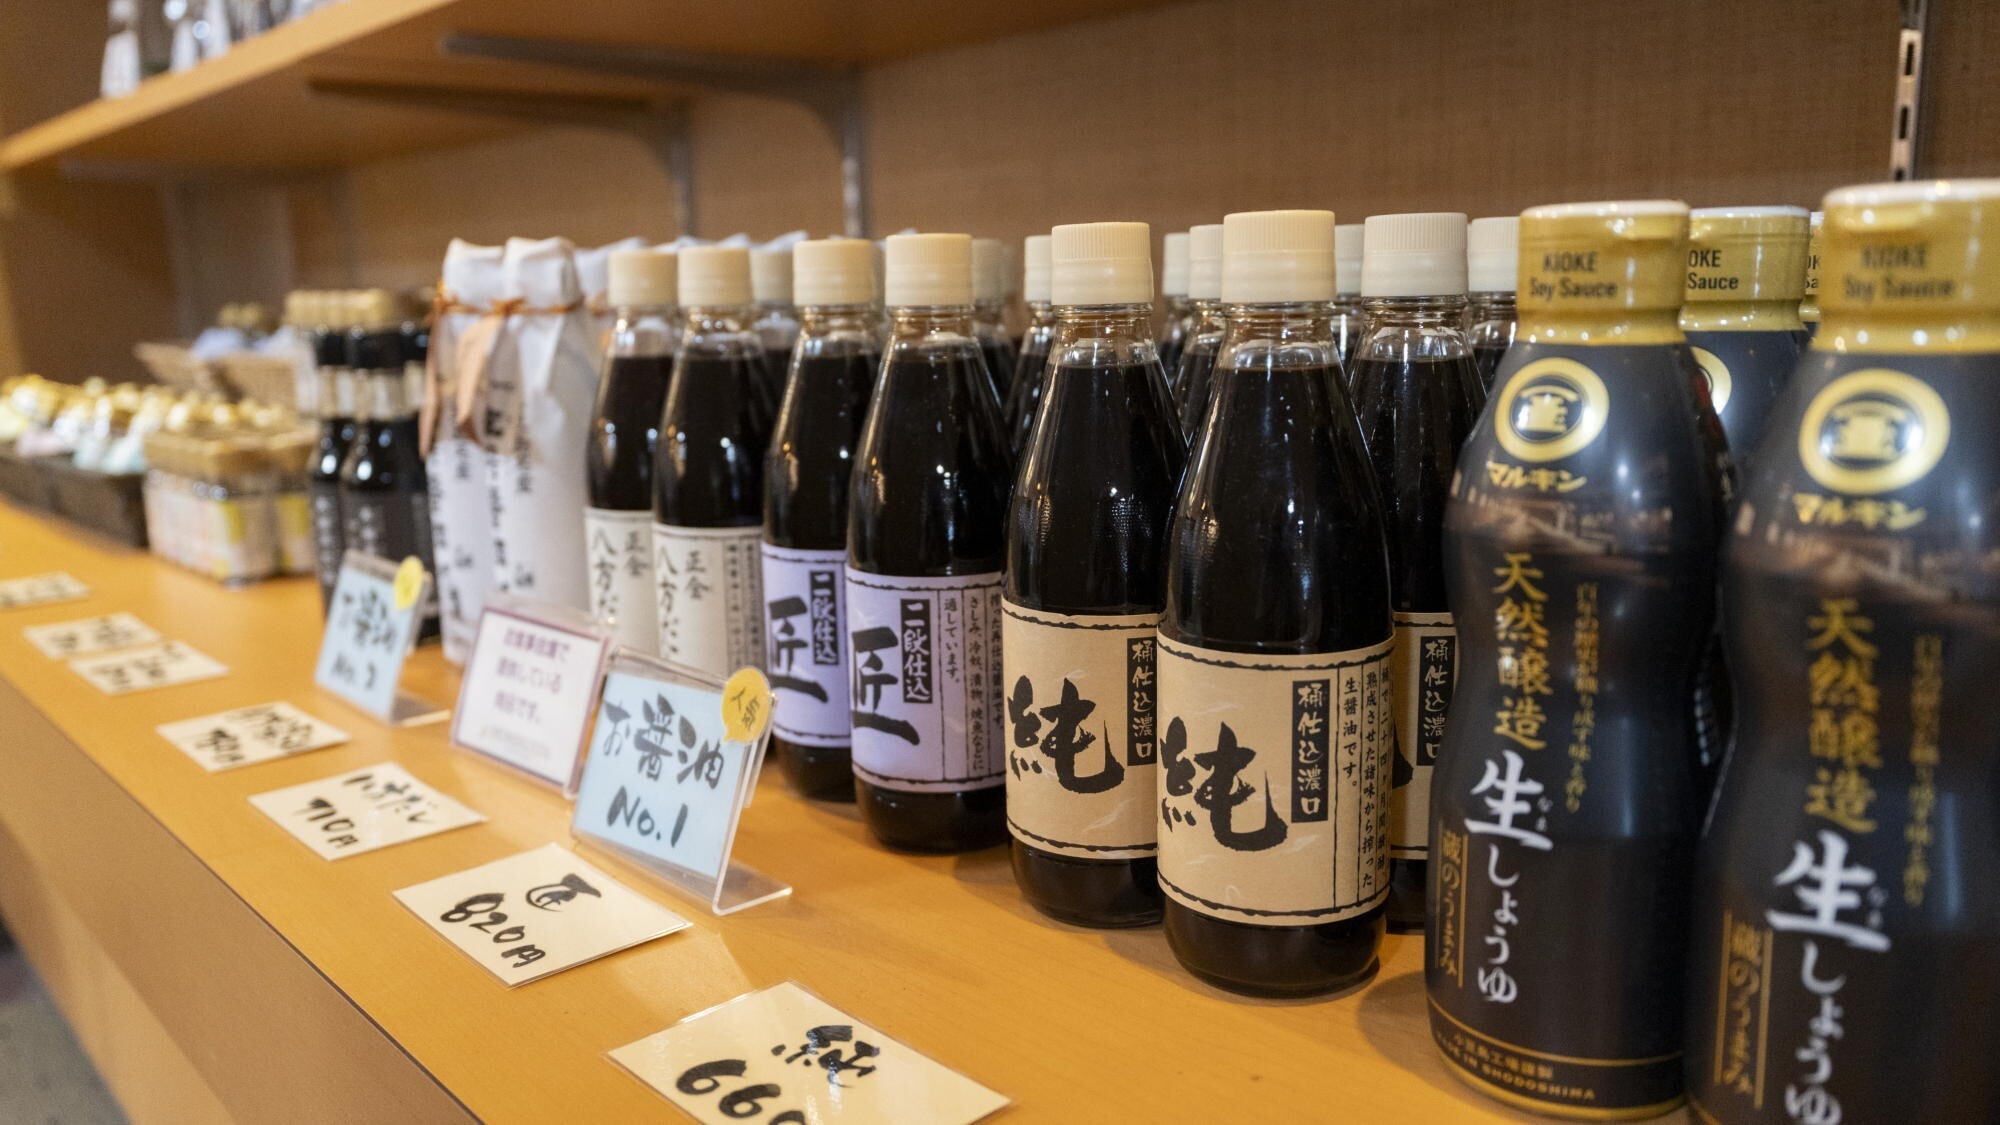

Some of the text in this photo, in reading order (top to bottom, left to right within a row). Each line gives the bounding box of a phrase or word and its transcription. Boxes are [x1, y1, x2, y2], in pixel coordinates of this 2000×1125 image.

[1529, 277, 1617, 301] Soy Sauce
[1542, 251, 1598, 272] KIOKE
[1687, 272, 1739, 290] Sauce
[1688, 249, 1722, 268] OKE
[1488, 461, 1587, 492] マルキン
[768, 594, 829, 704] 匠
[812, 571, 838, 663] 二段仕込
[902, 601, 931, 702] 二段仕込
[1492, 552, 1553, 751] 天然醸造
[850, 626, 921, 746] 匠
[1007, 675, 1126, 794] 純
[1131, 640, 1155, 759] 桶仕込濃口
[1342, 677, 1360, 787] 生醤油です。
[1806, 598, 1882, 834] 天然醸造
[603, 693, 725, 790] お醤油
[1159, 715, 1290, 852] 純
[1297, 682, 1326, 817] 桶仕込濃口
[1362, 670, 1378, 889] 熟成させた諸味から搾った
[607, 785, 689, 848] No.1
[440, 892, 546, 969] 820円
[1464, 750, 1554, 1003] 生しょうゆ
